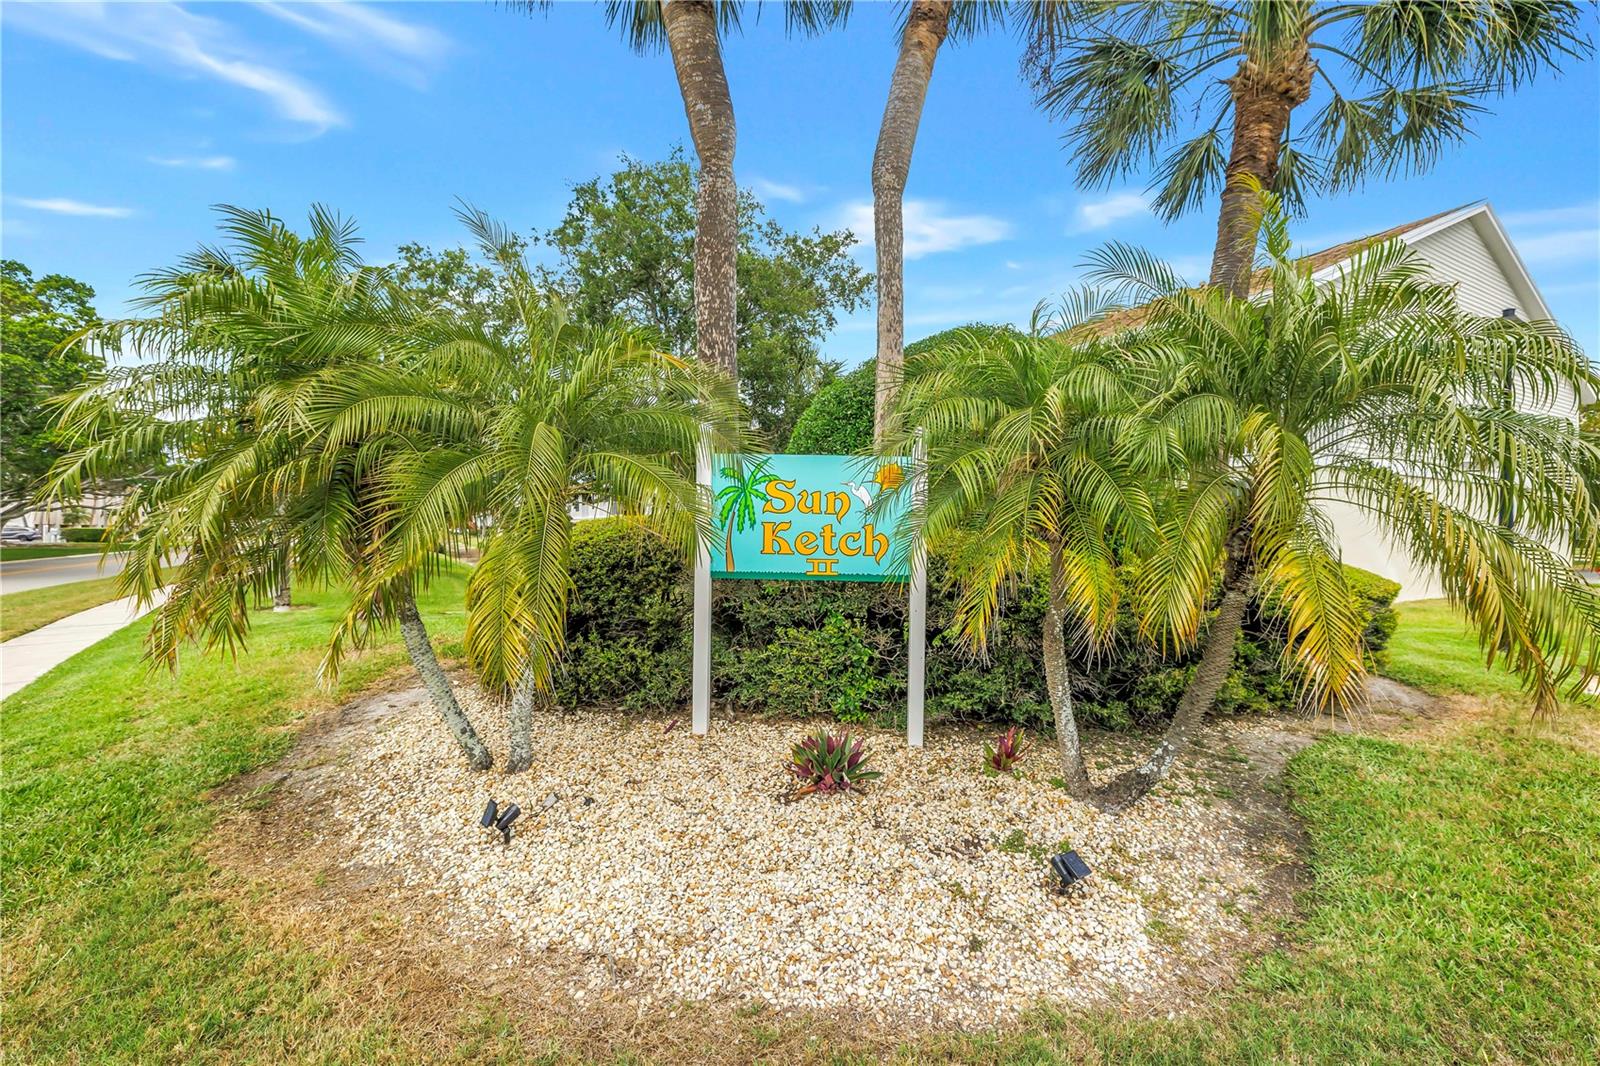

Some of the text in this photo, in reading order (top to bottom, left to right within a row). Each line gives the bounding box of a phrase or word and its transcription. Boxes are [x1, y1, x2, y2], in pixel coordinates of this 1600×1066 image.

[762, 479, 851, 524] Sun
[761, 520, 889, 565] Ketch
[805, 558, 838, 576] II
